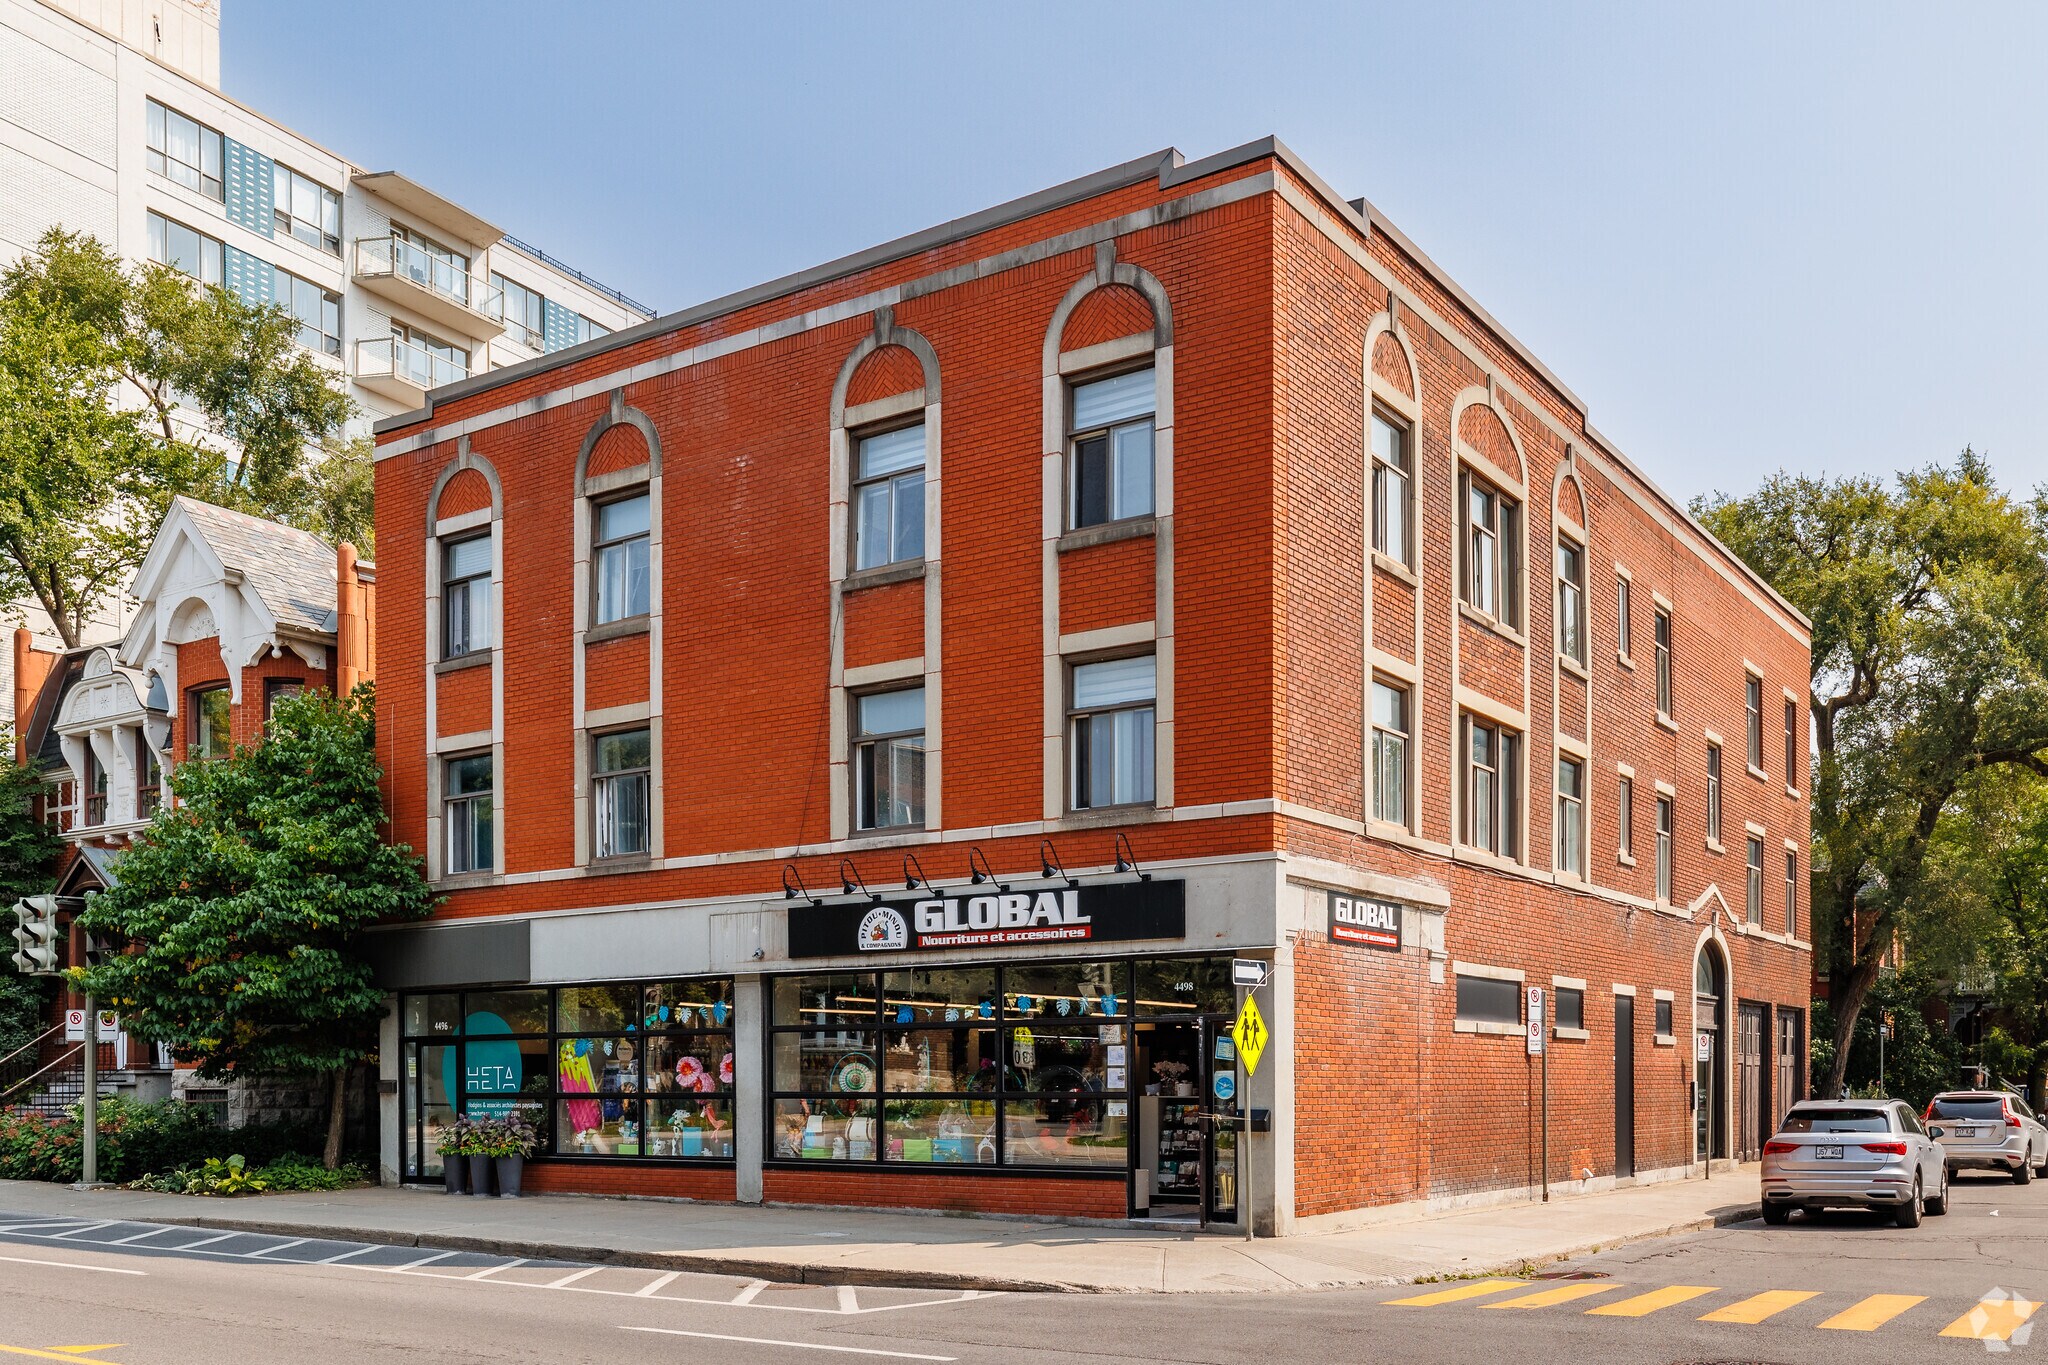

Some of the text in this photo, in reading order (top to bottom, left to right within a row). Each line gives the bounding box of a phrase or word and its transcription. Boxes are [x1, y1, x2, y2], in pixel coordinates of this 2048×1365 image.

[914, 890, 1091, 933] GLOBAL
[1335, 897, 1397, 931] GLOBAL
[922, 928, 1086, 946] Nourriture et accessoires
[1174, 982, 1194, 991] 4498
[435, 1021, 448, 1030] 4496
[467, 1066, 516, 1090] HETA
